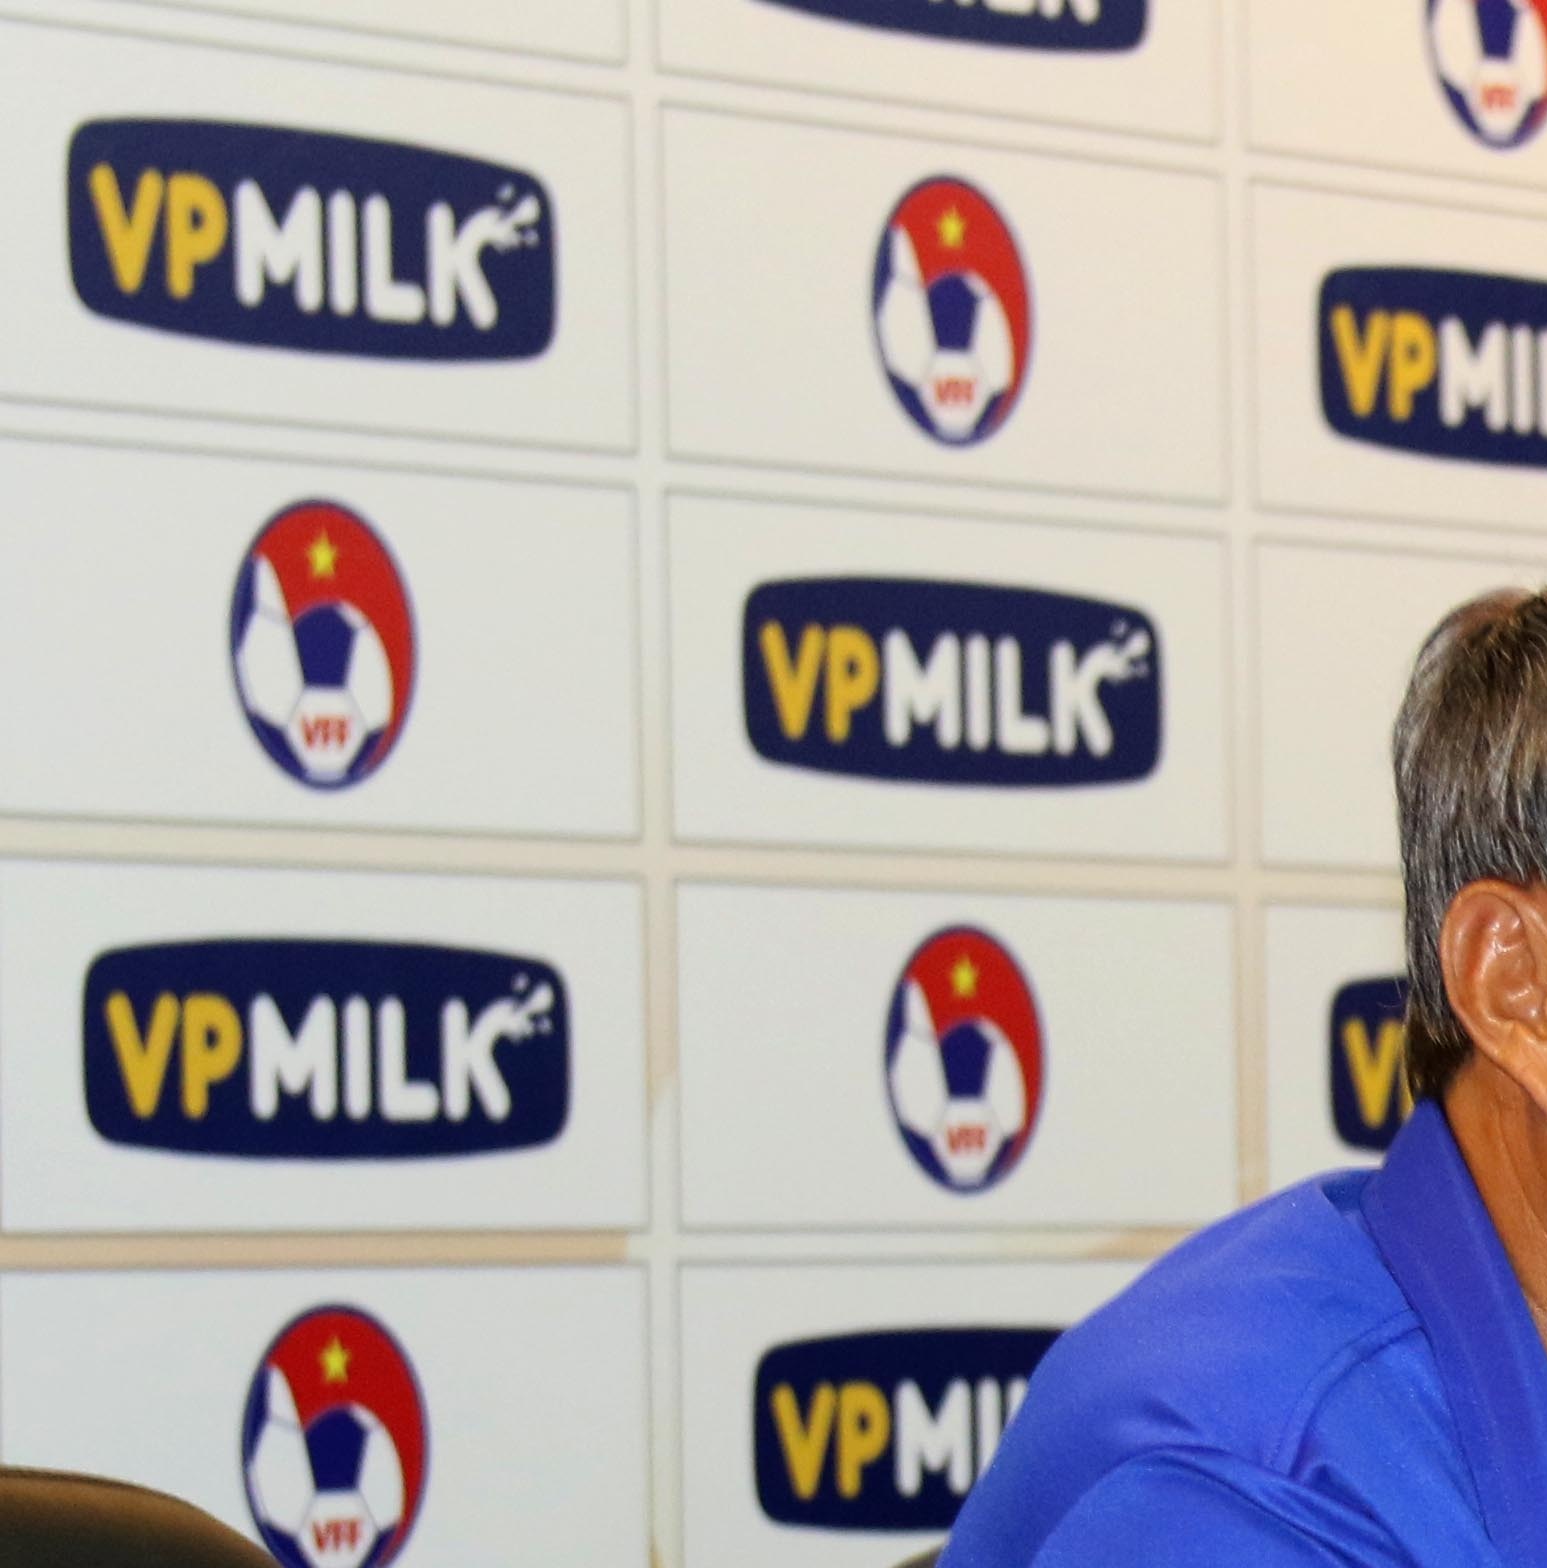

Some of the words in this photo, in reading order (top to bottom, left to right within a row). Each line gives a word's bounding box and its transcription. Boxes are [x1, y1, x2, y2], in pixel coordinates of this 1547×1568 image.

[89, 163, 540, 331] VPMILK
[300, 714, 352, 752] VFF
[759, 621, 1149, 758] VPMILK
[105, 990, 553, 1123] VPMILK
[946, 1124, 988, 1155] VFF
[772, 1376, 1029, 1499] VPMI
[312, 1518, 363, 1553] VFF
